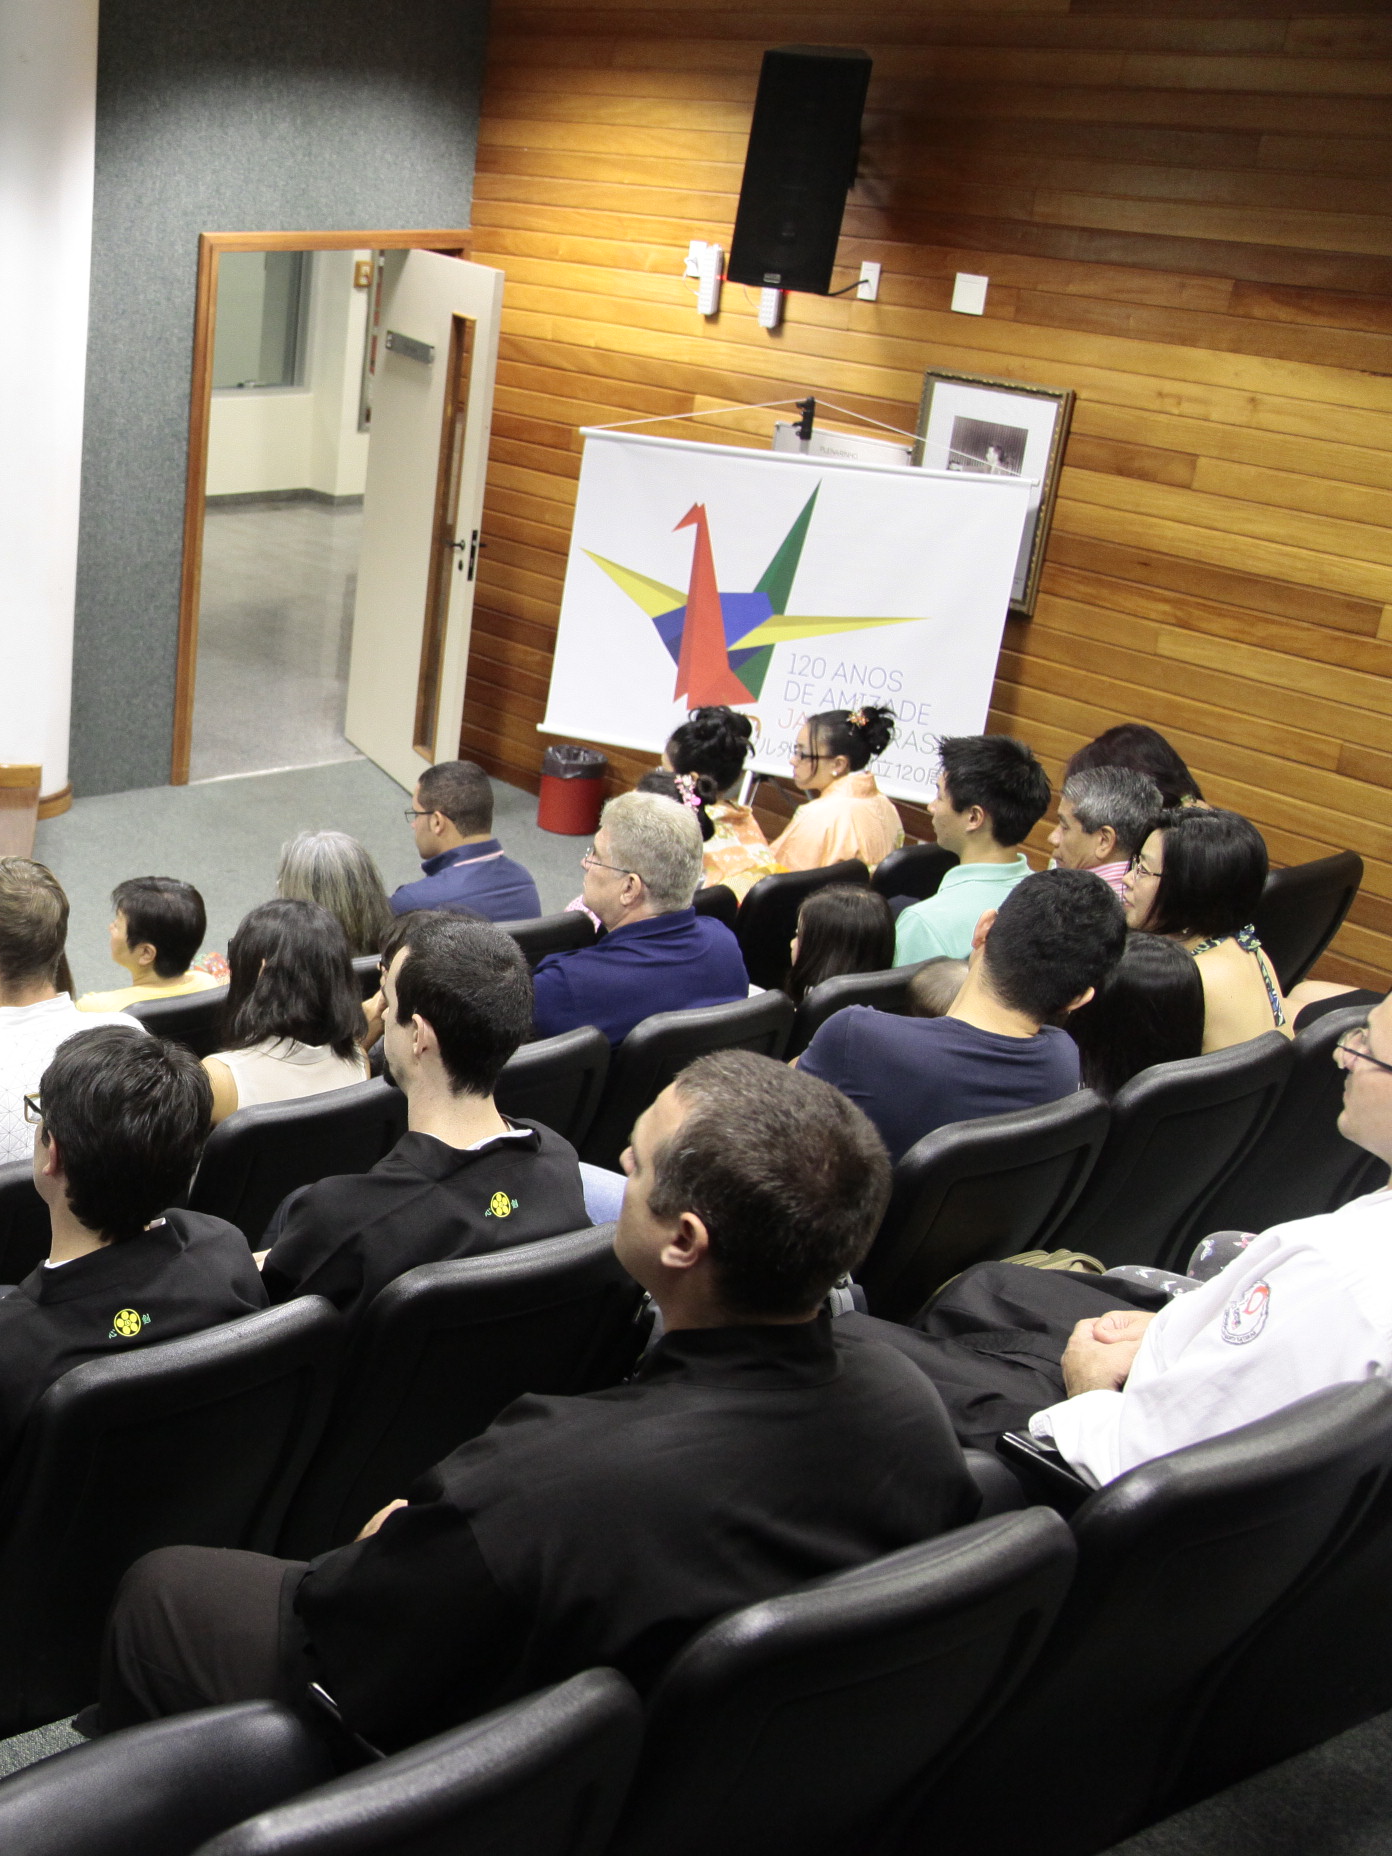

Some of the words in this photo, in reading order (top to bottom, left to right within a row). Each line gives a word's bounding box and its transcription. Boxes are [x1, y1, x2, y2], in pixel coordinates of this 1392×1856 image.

[786, 653, 827, 680] 120
[831, 661, 904, 693] ANOS
[783, 680, 815, 706] DE
